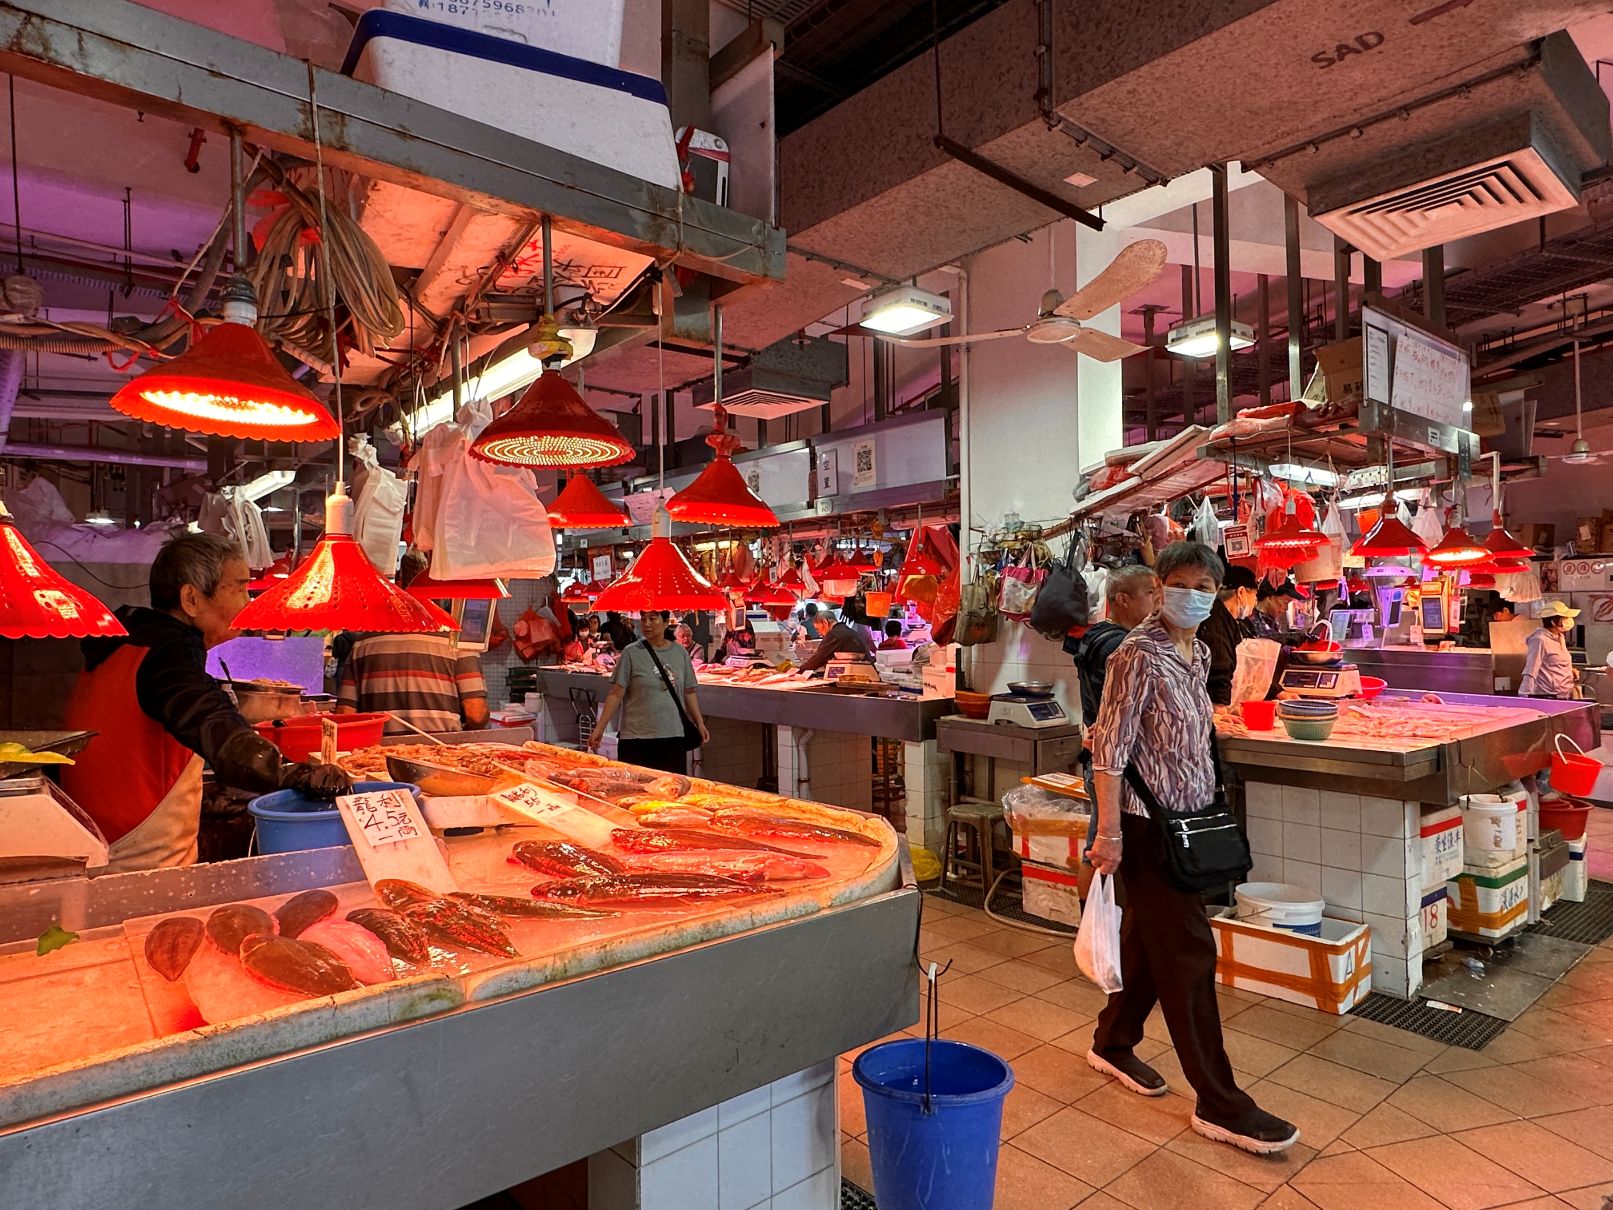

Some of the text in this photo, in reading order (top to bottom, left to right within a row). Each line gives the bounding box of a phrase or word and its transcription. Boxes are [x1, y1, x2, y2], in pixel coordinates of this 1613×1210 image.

[1311, 31, 1385, 70] SAD
[353, 792, 401, 814] 龍利
[364, 810, 412, 832] 4.5元
[1424, 903, 1438, 932] 18
